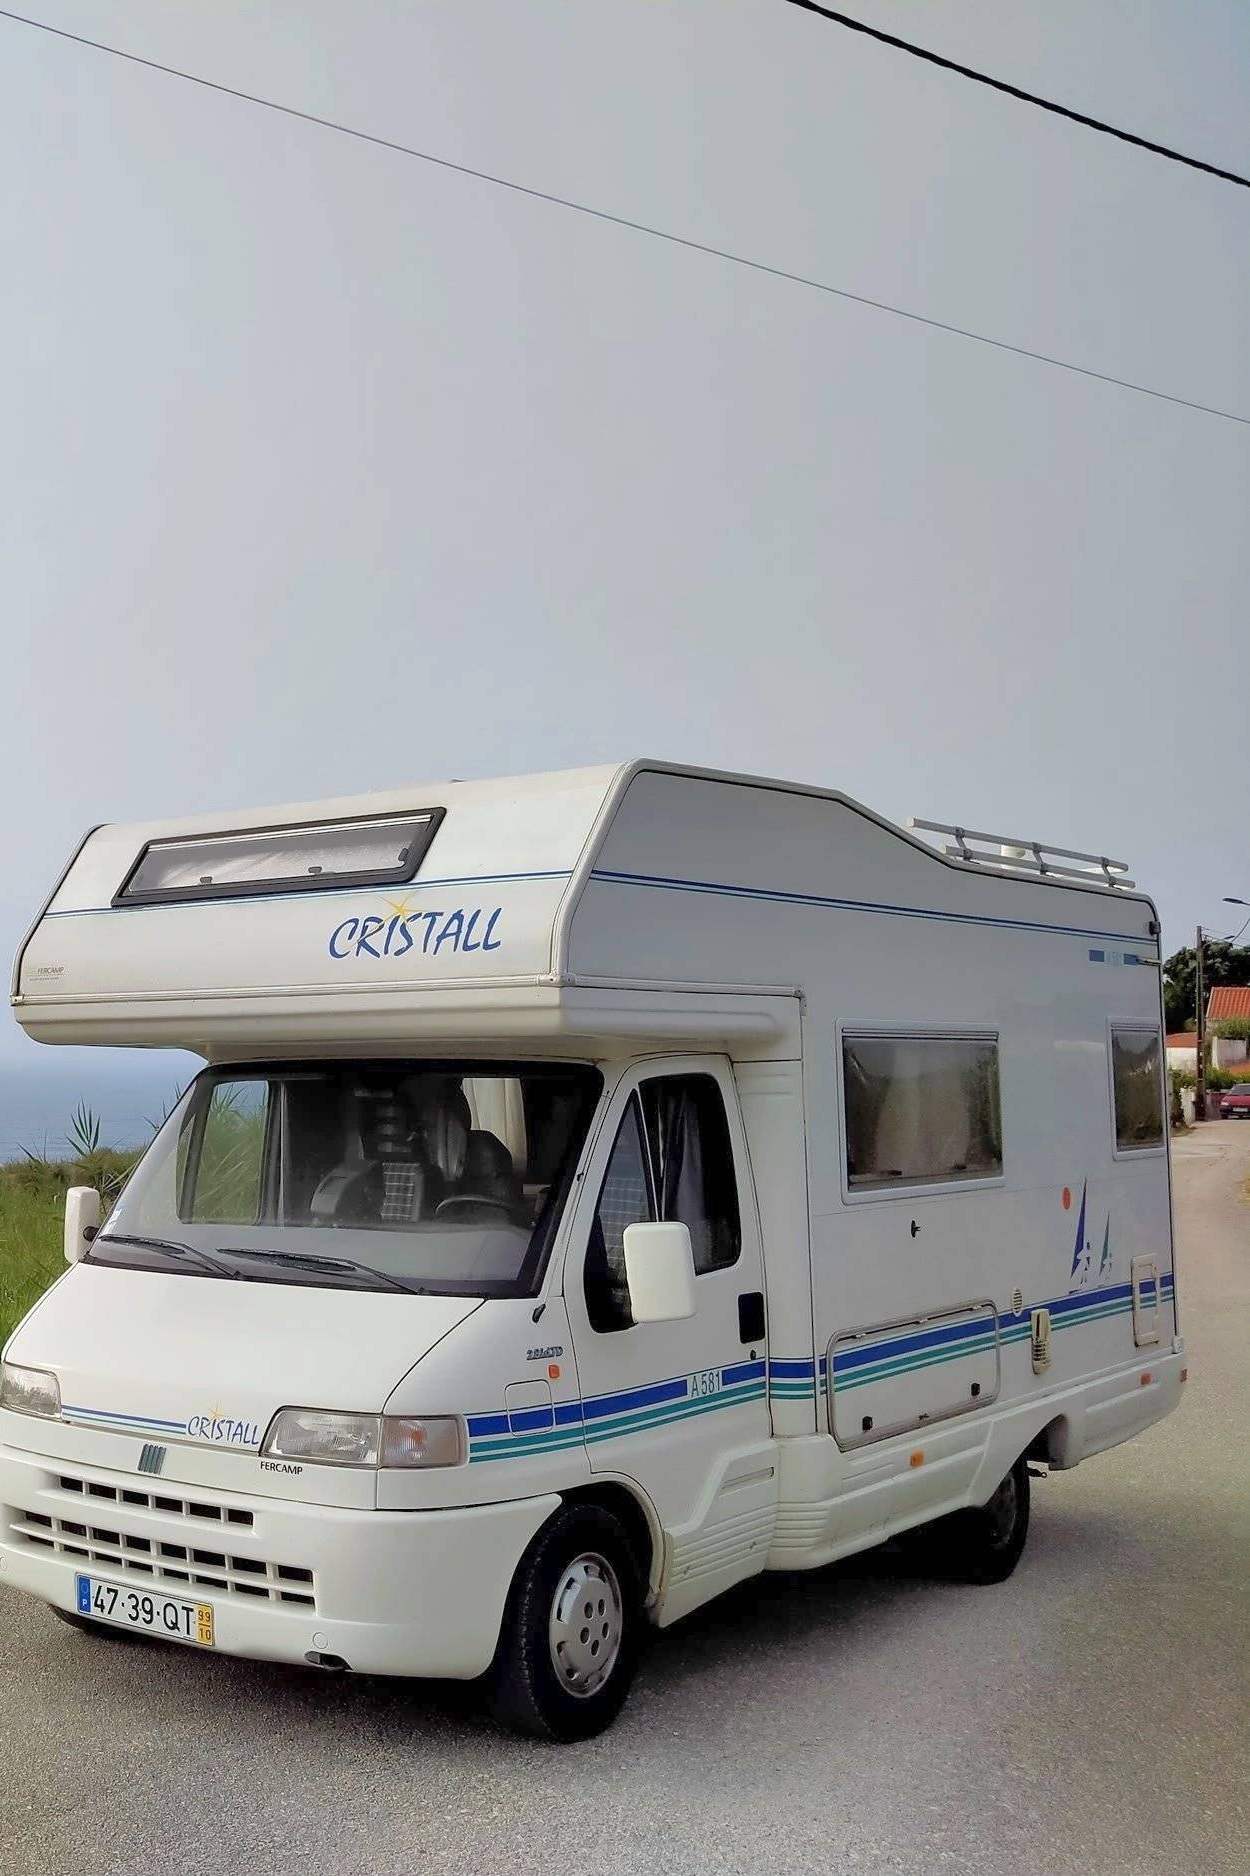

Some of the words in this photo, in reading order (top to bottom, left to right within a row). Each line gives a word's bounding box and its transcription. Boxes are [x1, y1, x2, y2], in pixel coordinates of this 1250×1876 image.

[329, 907, 503, 959] CRISTALL
[691, 1375, 700, 1398] A
[701, 1370, 720, 1395] 581
[187, 1415, 260, 1445] CRISTALL
[260, 1461, 303, 1475] FERCAMP
[81, 1599, 88, 1607] P
[198, 1609, 211, 1623] 99
[198, 1628, 212, 1641] 10
